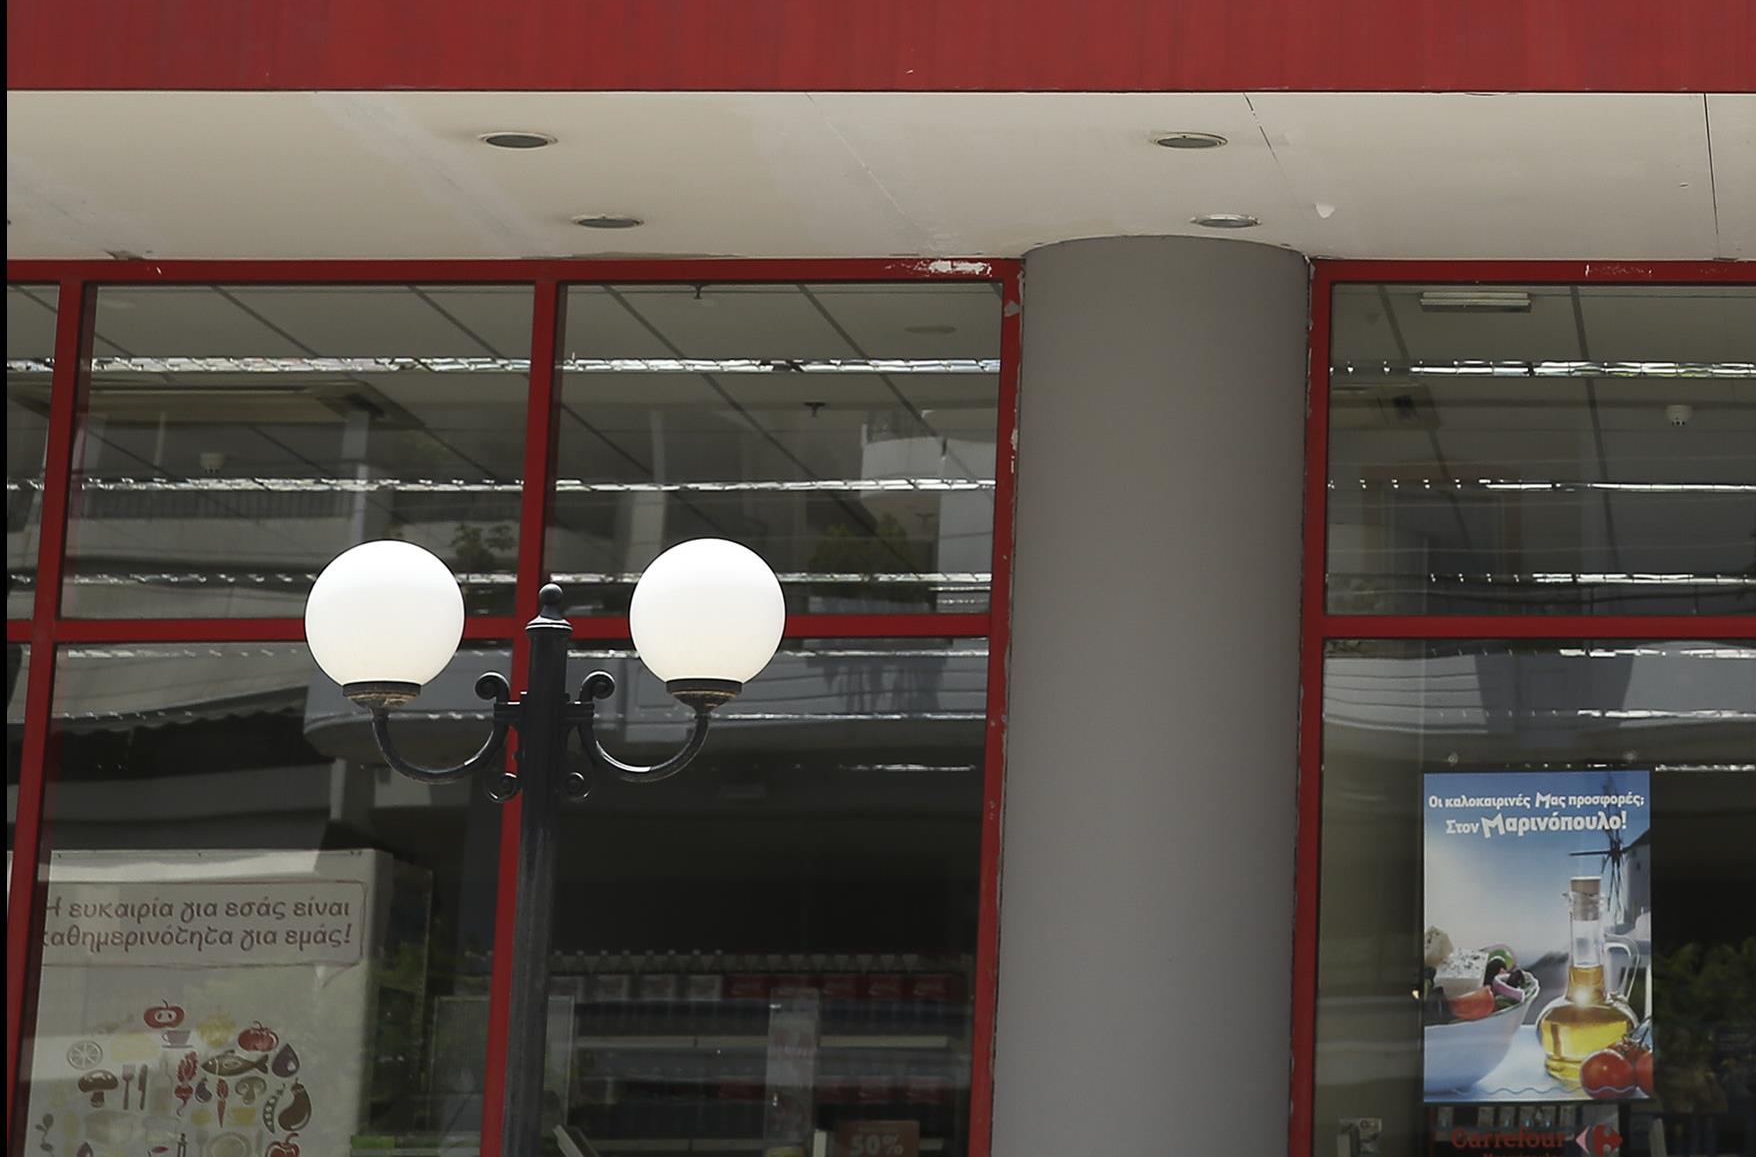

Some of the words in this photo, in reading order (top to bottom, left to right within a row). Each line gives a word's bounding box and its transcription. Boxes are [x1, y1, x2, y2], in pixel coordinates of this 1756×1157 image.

[1429, 796, 1443, 808] Οι
[1444, 793, 1530, 809] καλοκαιρινές
[1535, 791, 1566, 809] Μας
[1568, 792, 1645, 807] προσφορές;
[1446, 819, 1479, 835] Στον
[1482, 812, 1627, 839] Μαρινόπουλο!
[69, 896, 174, 924] ευκαιρία
[179, 899, 218, 923] για
[225, 897, 286, 921] εσάς
[293, 896, 350, 918] είναι
[240, 928, 278, 951] για
[284, 924, 353, 952] εμάς!
[1451, 1126, 1566, 1149] Carrefour
